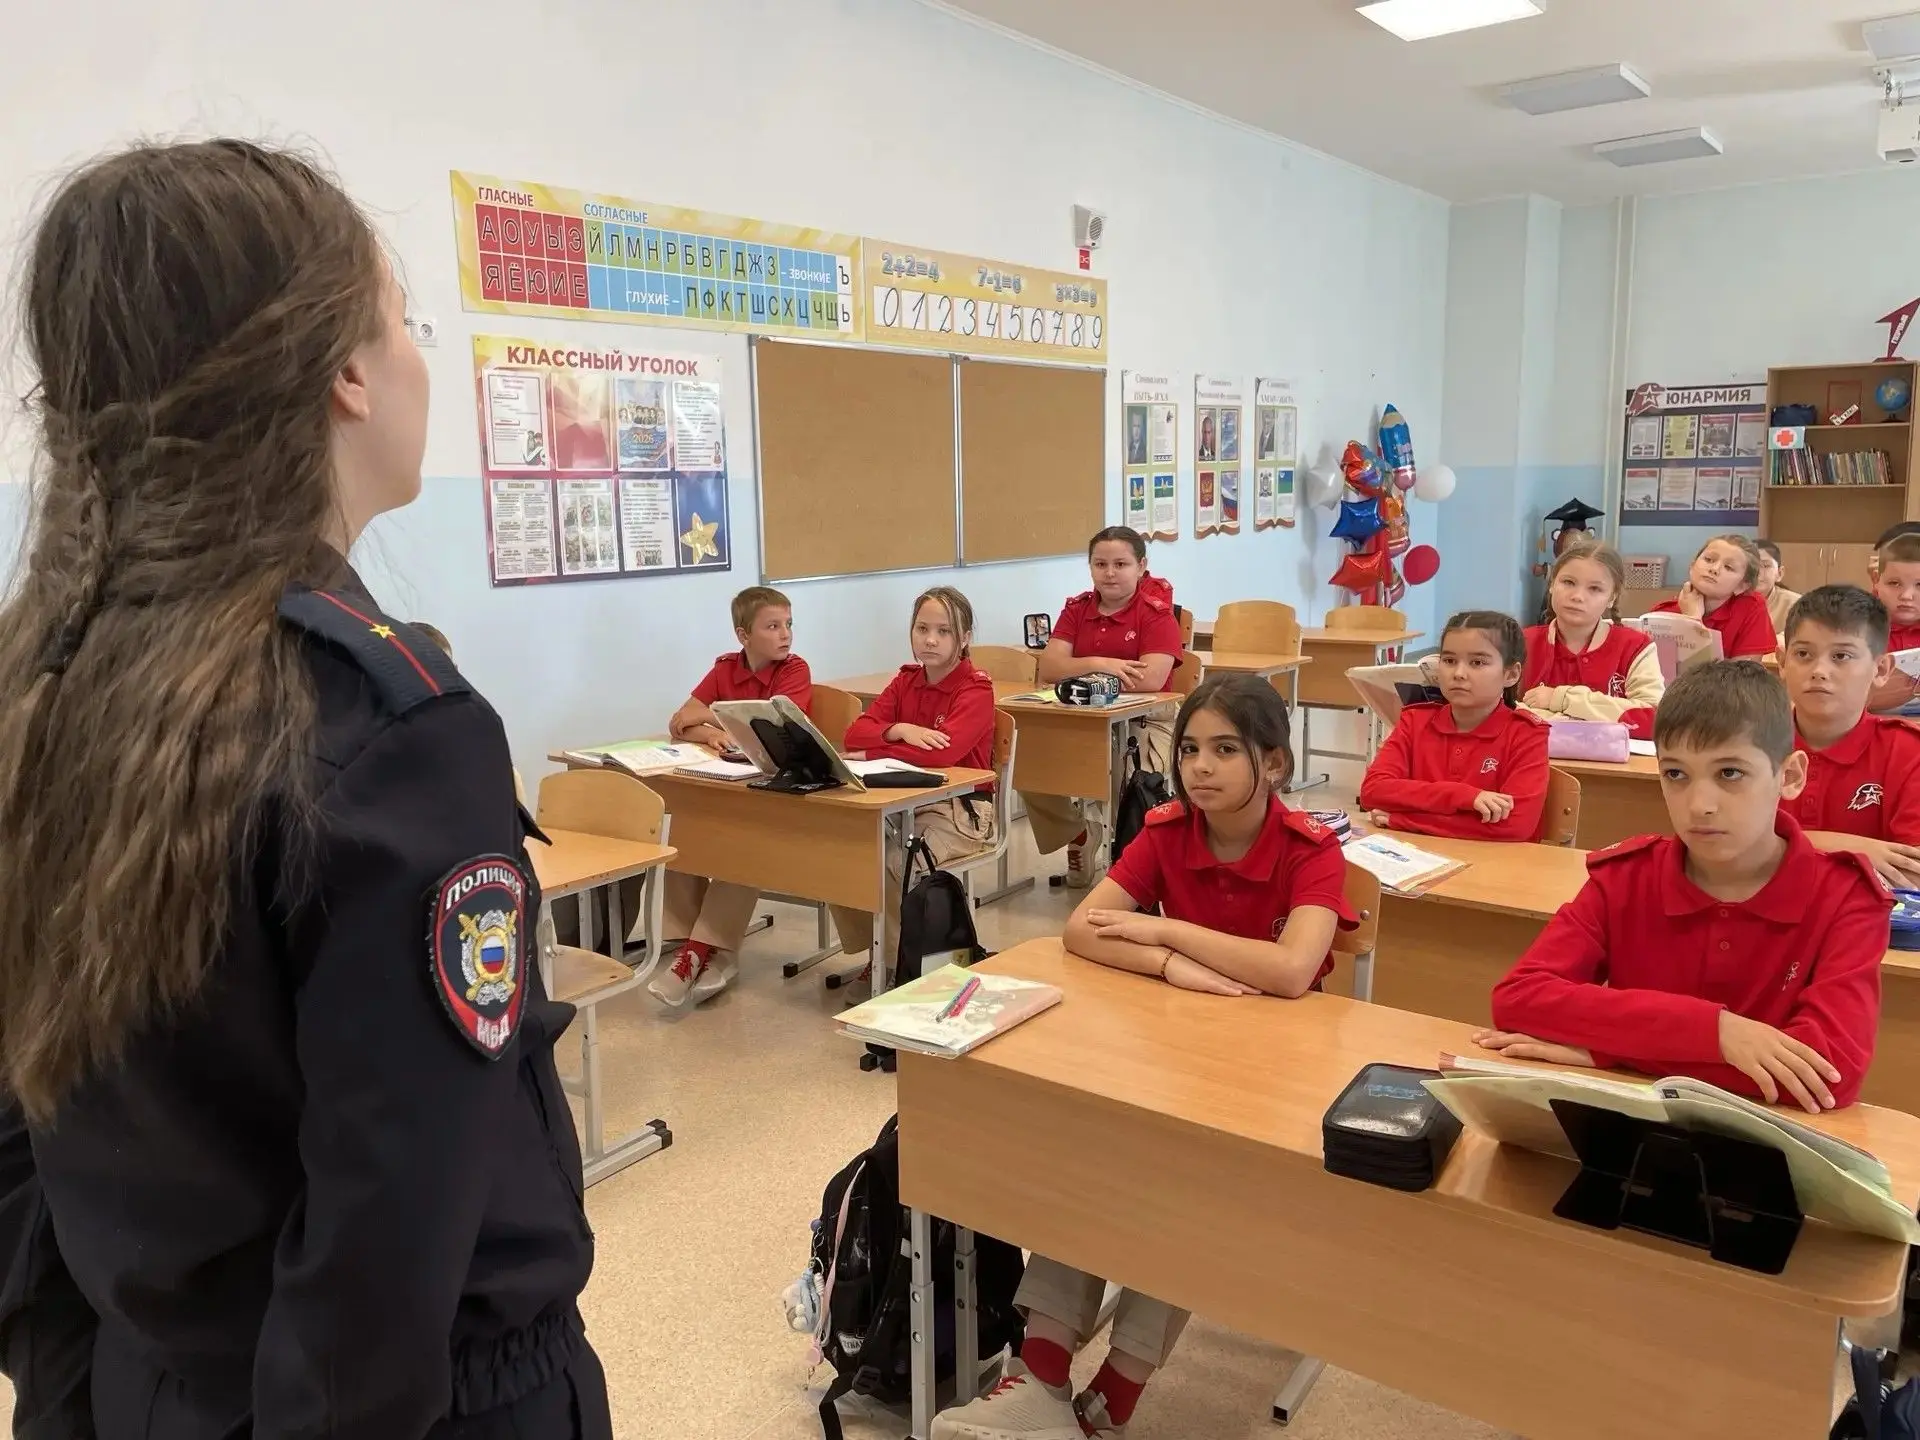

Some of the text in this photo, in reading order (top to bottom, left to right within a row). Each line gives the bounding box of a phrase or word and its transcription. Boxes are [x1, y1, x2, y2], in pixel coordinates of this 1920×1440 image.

[478, 186, 534, 207] ГЛАСНЫЕ
[583, 203, 648, 224] СОГЛАСНЫЕ
[482, 216, 583, 252] А О У Ы Э
[589, 226, 602, 254] Й
[609, 234, 621, 257] Л
[627, 236, 641, 260] М
[647, 239, 659, 261] Н
[666, 242, 676, 263] Р
[685, 245, 695, 266] Б
[702, 247, 712, 268] В
[719, 249, 727, 269] Г
[734, 252, 746, 277] Д
[749, 253, 763, 275] Ж
[767, 255, 776, 276] З
[788, 268, 831, 284] ЗВОНКИЕ
[838, 265, 850, 285] Ъ
[881, 251, 940, 283] 2+2=4
[486, 263, 587, 298] Я Ё Ю И Е
[625, 290, 670, 306] ГЛУХИЕ
[687, 286, 698, 308] П
[703, 289, 715, 310] Ф
[721, 290, 730, 311] К
[736, 292, 746, 313] Т
[752, 293, 765, 315] Ш
[768, 295, 779, 316] С
[784, 297, 794, 318] Х
[799, 299, 809, 324] Ц
[813, 300, 823, 321] Ч
[826, 301, 839, 326] Щ
[841, 303, 850, 323] Ь
[883, 287, 1103, 349] 0 1 2 3 4 5 6 7 8 9
[507, 345, 698, 377] КЛАССНЫЙ УГОЛОК
[1665, 388, 1751, 405] ЮНАРМИЯ
[446, 866, 522, 911] ПОЛИЦИЯ
[476, 1013, 510, 1050] МВД
